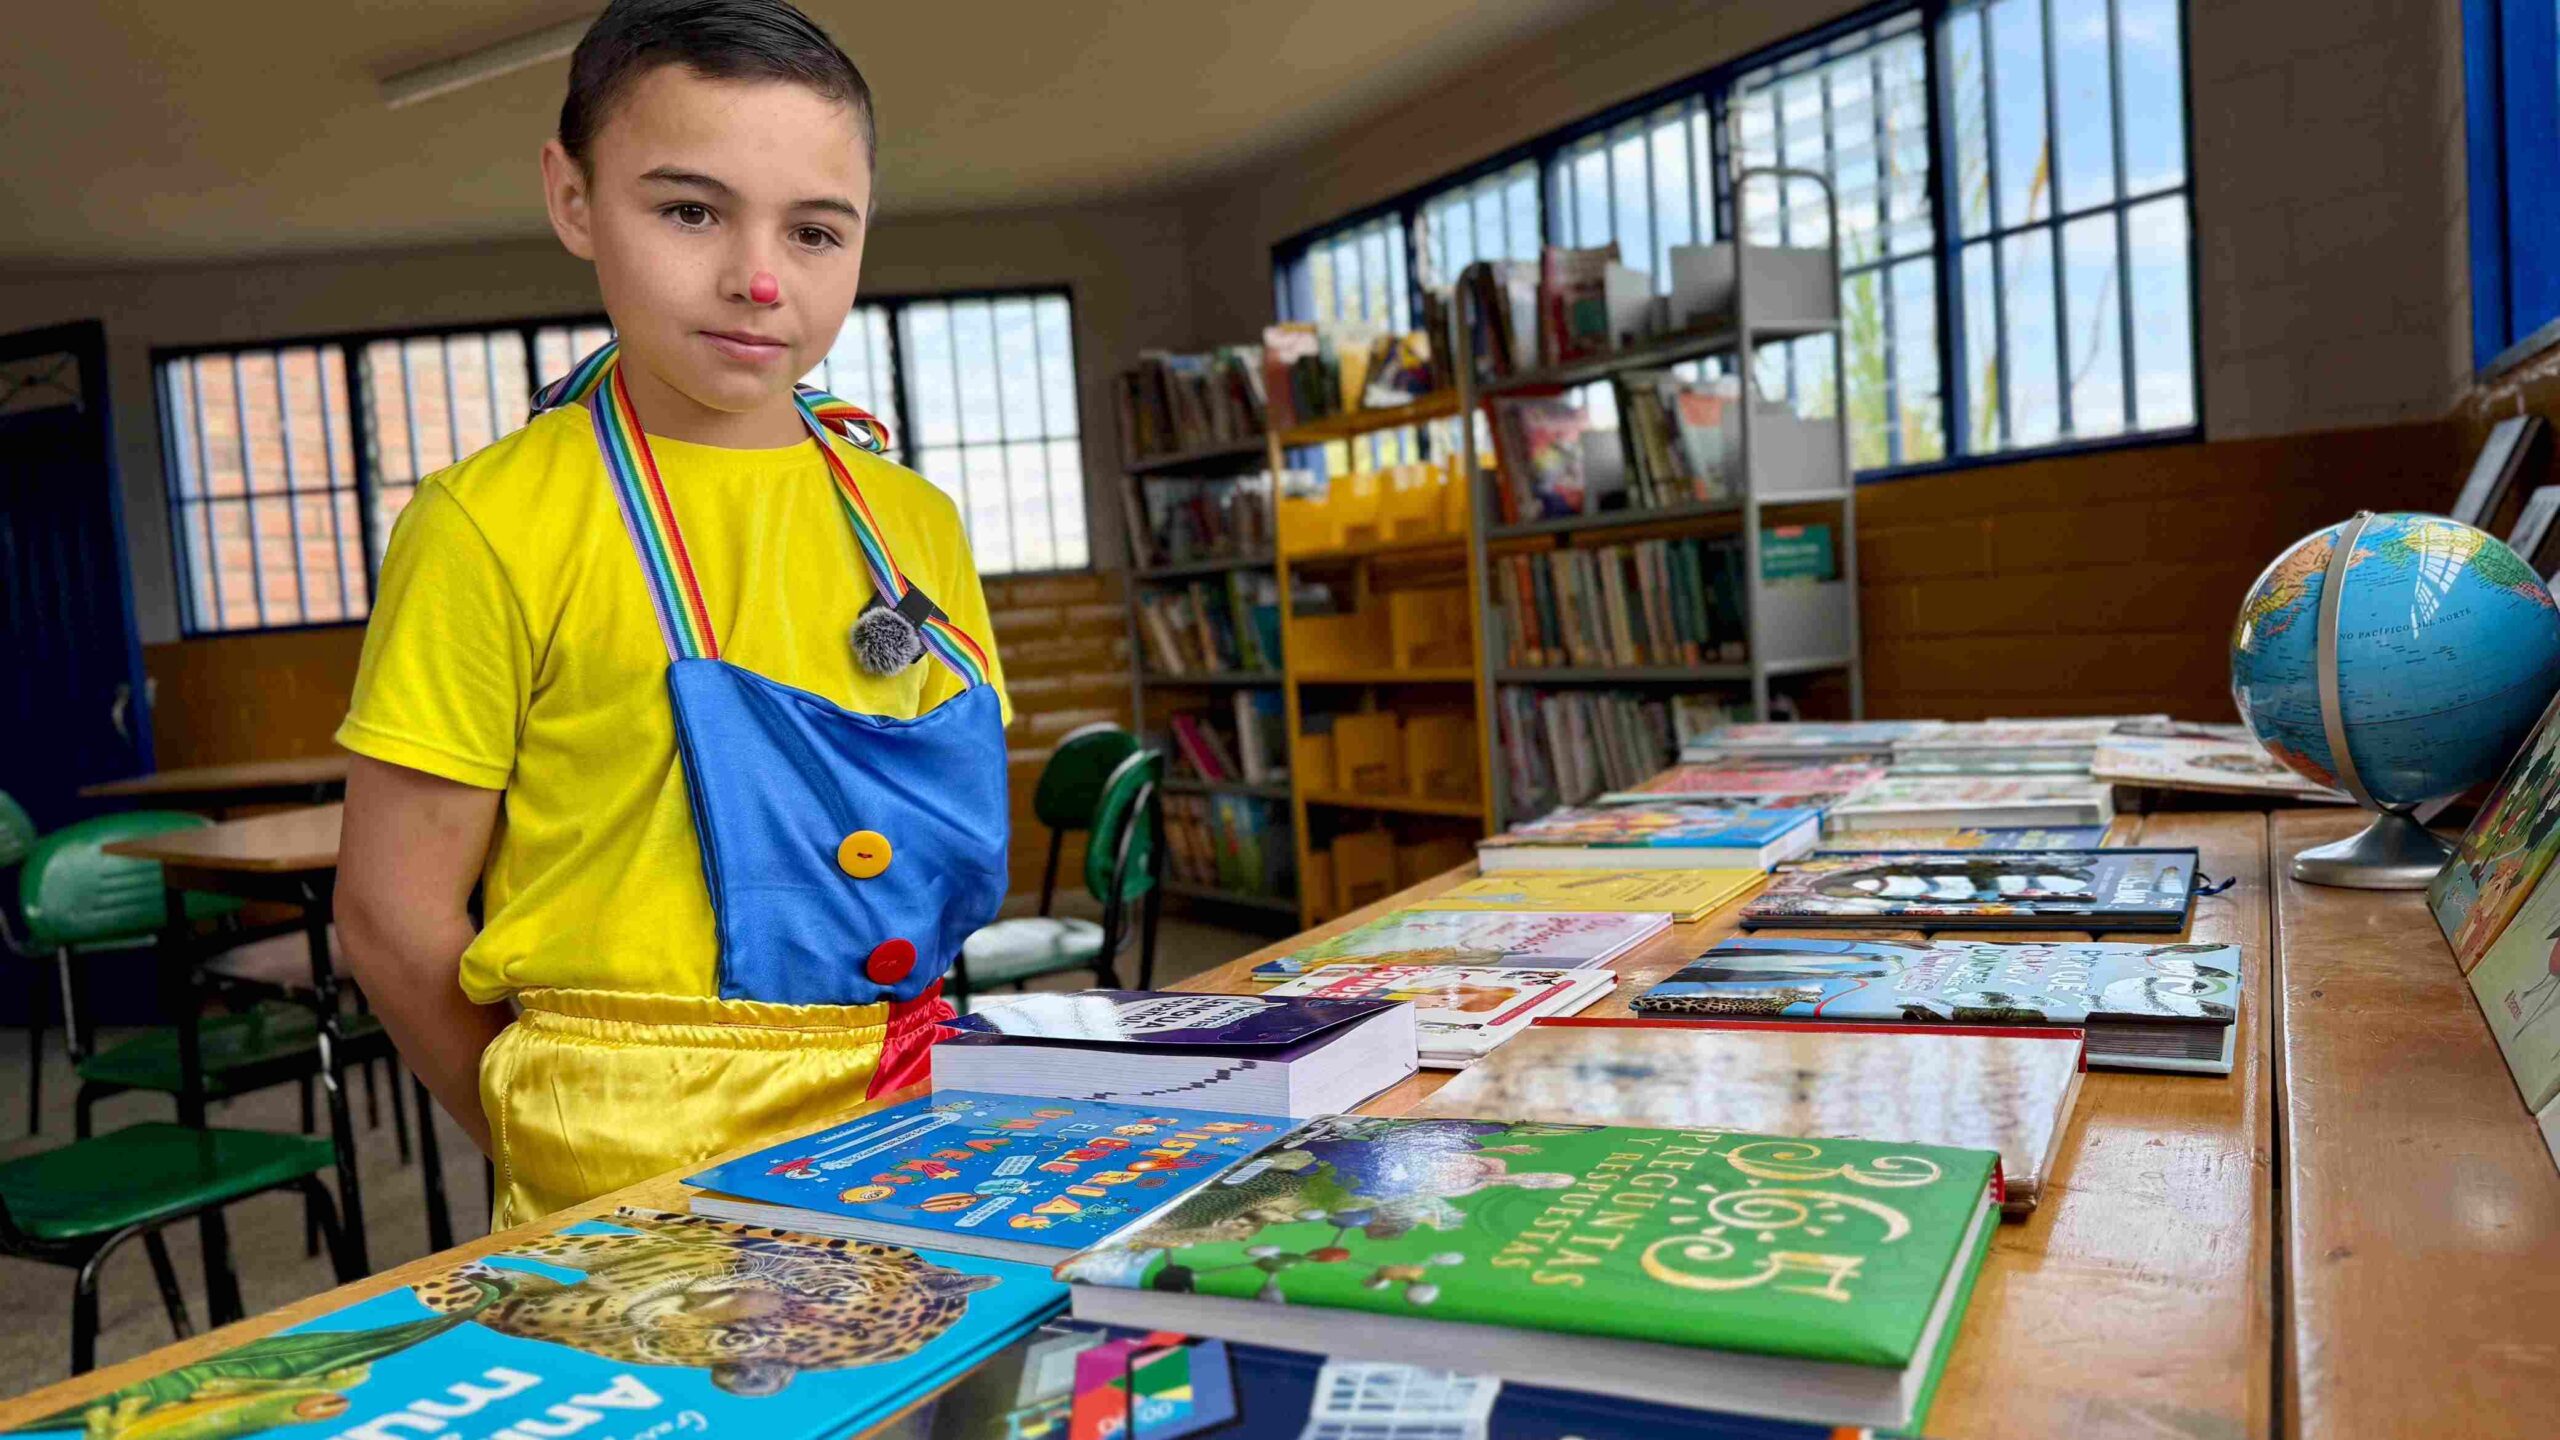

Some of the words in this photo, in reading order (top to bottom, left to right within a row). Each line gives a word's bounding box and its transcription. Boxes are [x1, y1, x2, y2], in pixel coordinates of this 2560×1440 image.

[2439, 607, 2472, 624] NORTE
[1135, 999, 1239, 1029] LENGUA
[838, 1108, 1076, 1203] UNIVERSO
[1038, 1117, 1179, 1173] SOBRE
[1065, 1122, 1099, 1134] EL
[1624, 1136, 1664, 1147] Y
[1491, 1151, 1643, 1270] RESPUESTAS
[1531, 1132, 1720, 1288] PREGUNTAS
[1641, 1141, 1942, 1301] 365
